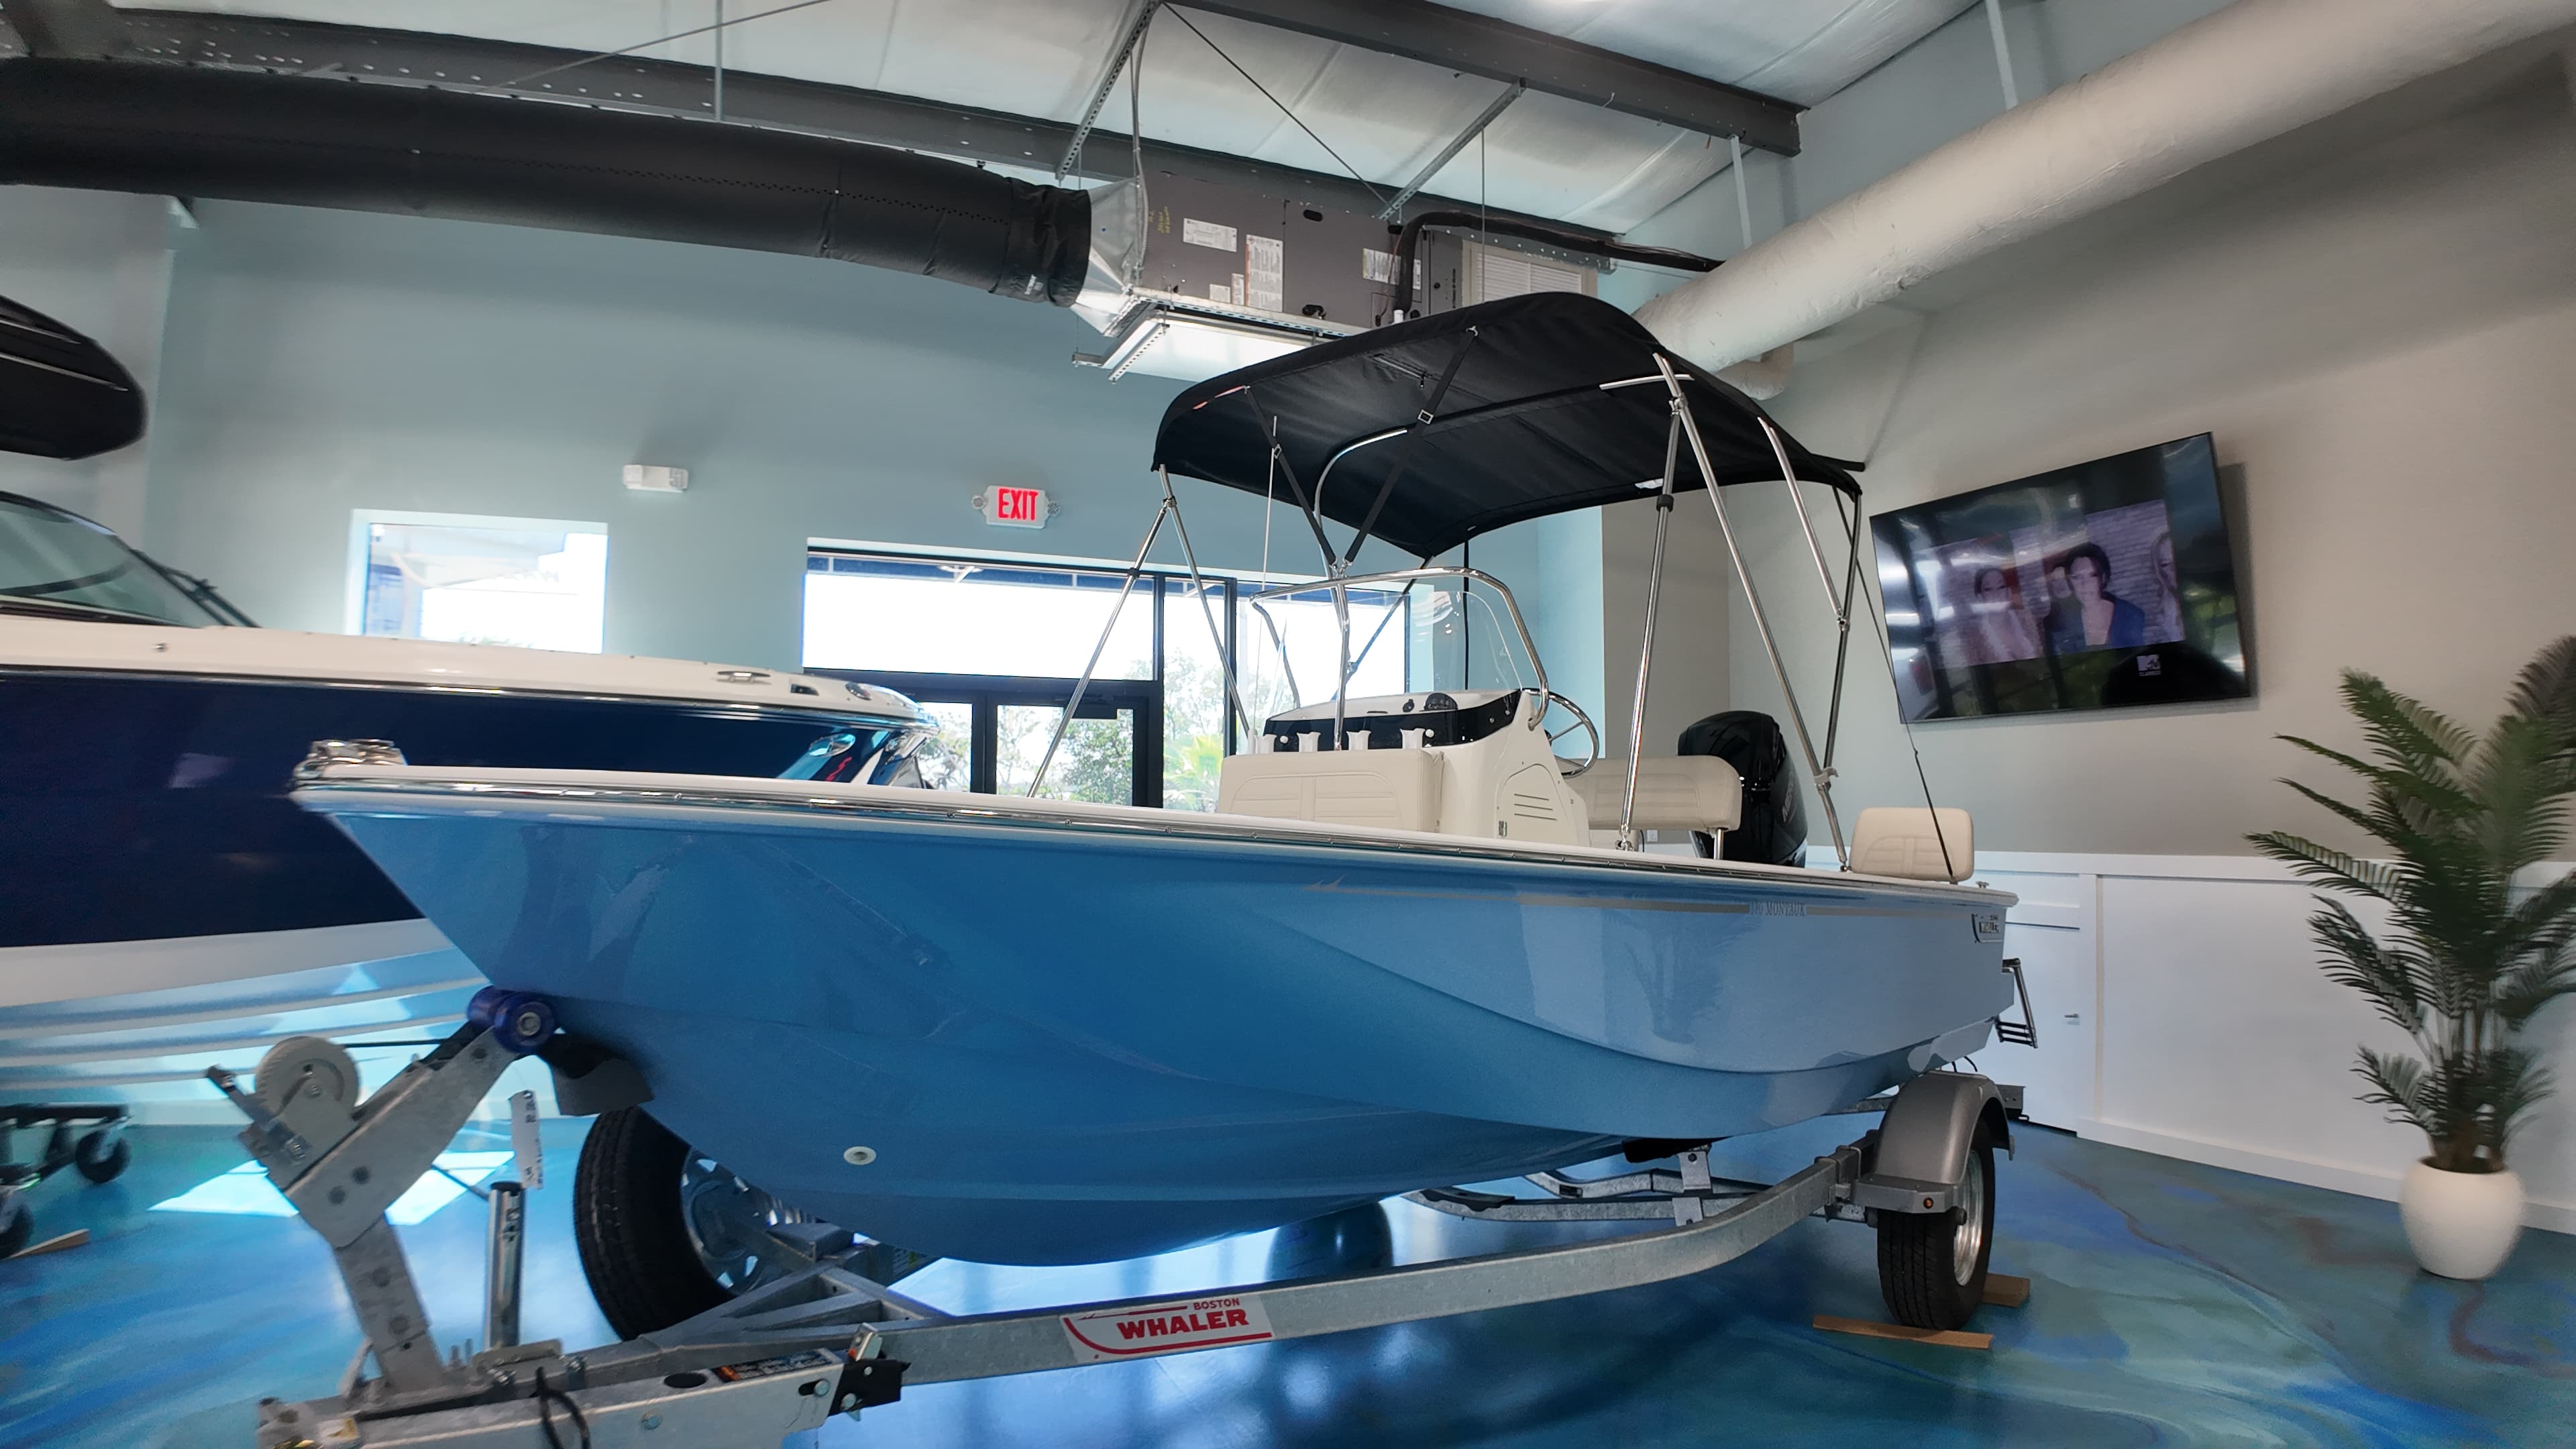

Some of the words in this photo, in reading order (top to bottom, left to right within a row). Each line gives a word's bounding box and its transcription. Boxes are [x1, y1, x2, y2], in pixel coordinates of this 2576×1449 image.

[998, 488, 1039, 521] EXIT
[1766, 901, 1805, 917] MONTAUK
[1193, 1298, 1240, 1310] BOSTON
[1117, 1309, 1248, 1339] WHALER
